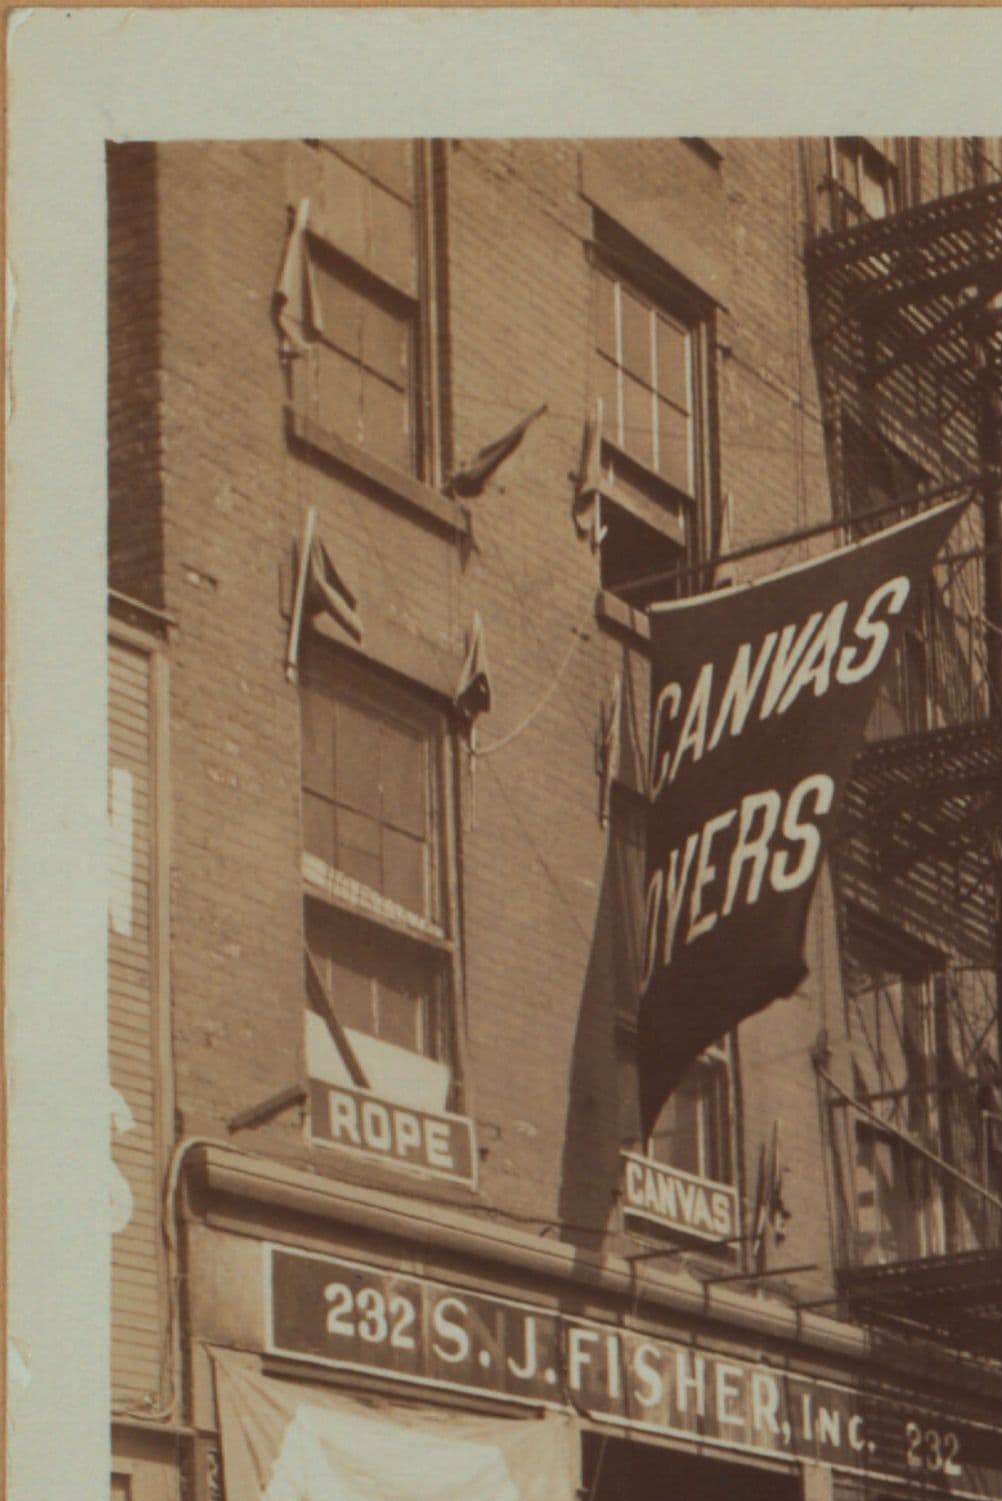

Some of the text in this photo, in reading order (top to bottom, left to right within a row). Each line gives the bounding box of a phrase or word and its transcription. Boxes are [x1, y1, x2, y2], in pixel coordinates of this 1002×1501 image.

[650, 575, 910, 801] CANVAS
[327, 1090, 455, 1170] ROPE
[624, 1158, 732, 1238] CANVAS
[323, 1282, 417, 1350] 232
[431, 1297, 492, 1369] S.
[508, 1315, 557, 1384] J.
[905, 1421, 962, 1476] 232
